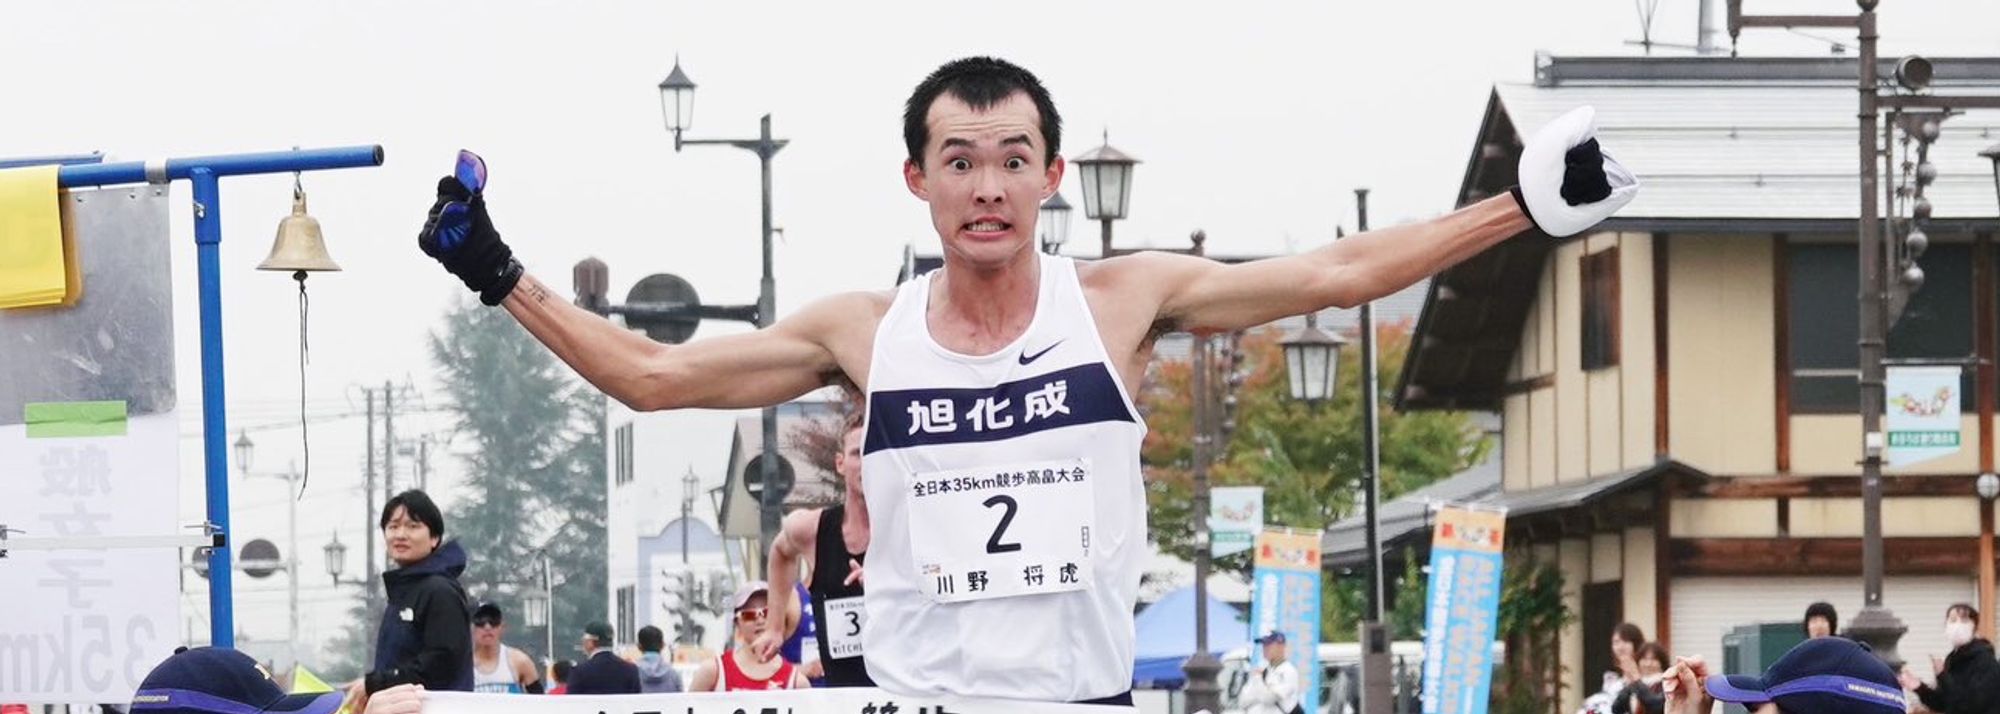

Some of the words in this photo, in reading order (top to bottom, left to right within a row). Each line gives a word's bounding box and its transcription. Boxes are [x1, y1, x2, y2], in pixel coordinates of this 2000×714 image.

[908, 380, 1071, 435] 旭化成
[982, 494, 1022, 554] 2
